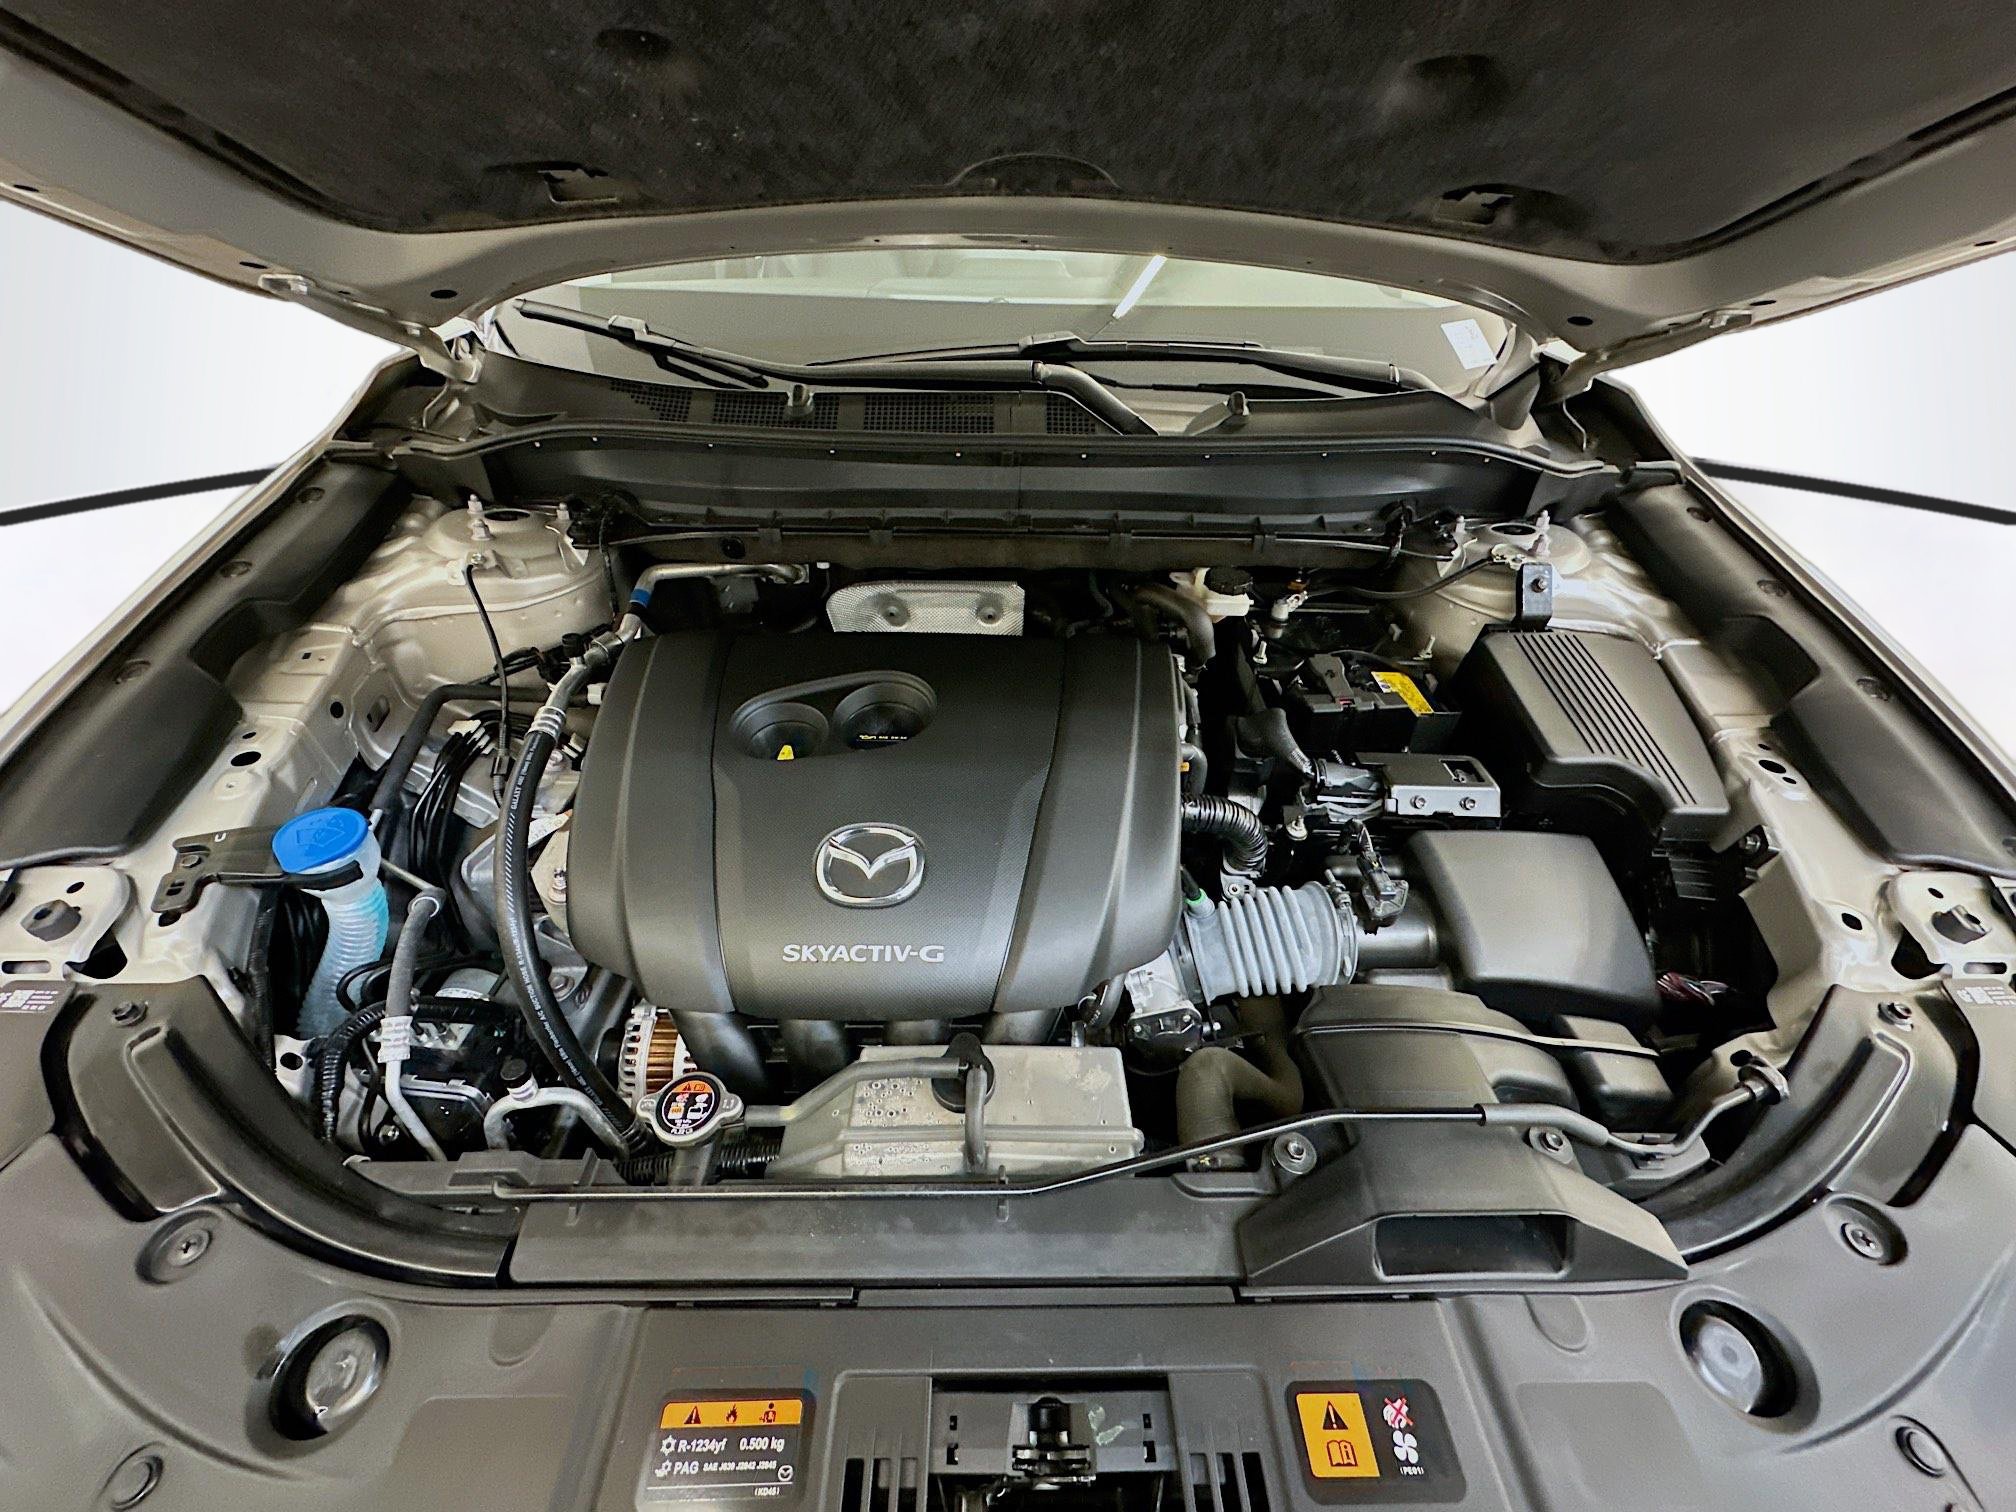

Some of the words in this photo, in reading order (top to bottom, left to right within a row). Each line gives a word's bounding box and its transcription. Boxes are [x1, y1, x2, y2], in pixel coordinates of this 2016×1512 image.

[782, 944, 945, 963] SKYACTIV-G
[527, 985, 541, 1011] SUCTION
[677, 1438, 728, 1455] R-1234yf
[739, 1437, 769, 1451] 0.500
[770, 1436, 785, 1453] kg
[673, 1460, 699, 1475] PAG
